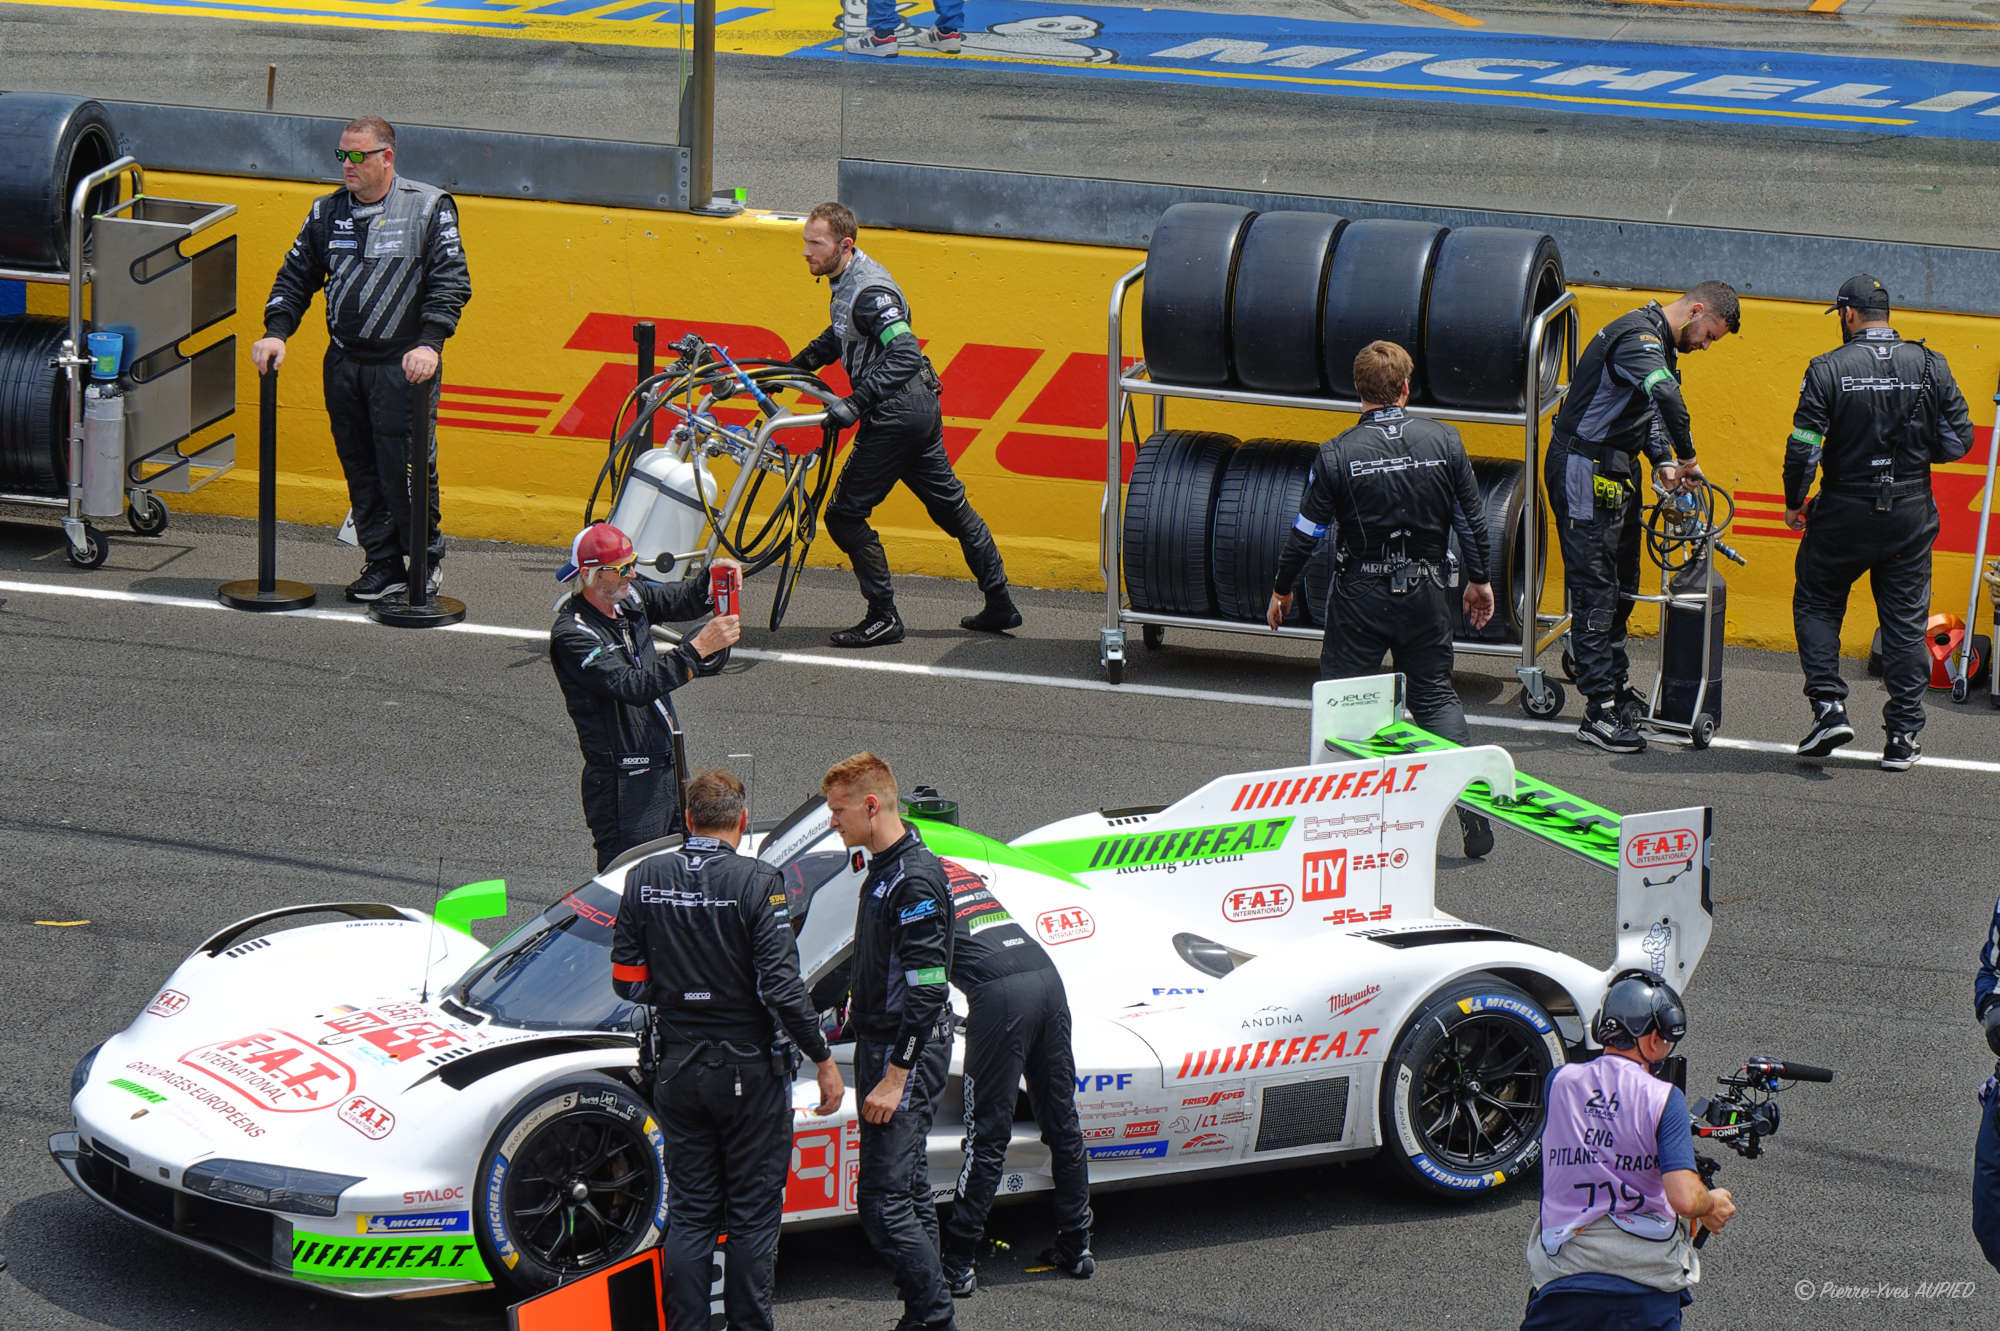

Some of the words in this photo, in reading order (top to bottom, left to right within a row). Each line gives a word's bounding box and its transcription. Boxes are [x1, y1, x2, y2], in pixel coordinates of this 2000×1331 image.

[1150, 37, 2000, 116] MICHELI
[1305, 857, 1344, 893] HY
[1327, 984, 1381, 1013] Milwaukee
[1241, 1013, 1303, 1029] ANDINA
[1485, 997, 1547, 1029] MICHELIN
[1075, 1073, 1132, 1093] YPF
[1584, 1128, 1613, 1148] ENG
[1711, 1128, 1739, 1137] RONIN
[1094, 1147, 1157, 1158] MICHELIN
[1418, 1159, 1481, 1188] MICHELIN
[403, 1186, 464, 1204] STALOC
[488, 1163, 506, 1243] MICHELIN
[389, 1217, 458, 1229] MICHELIN
